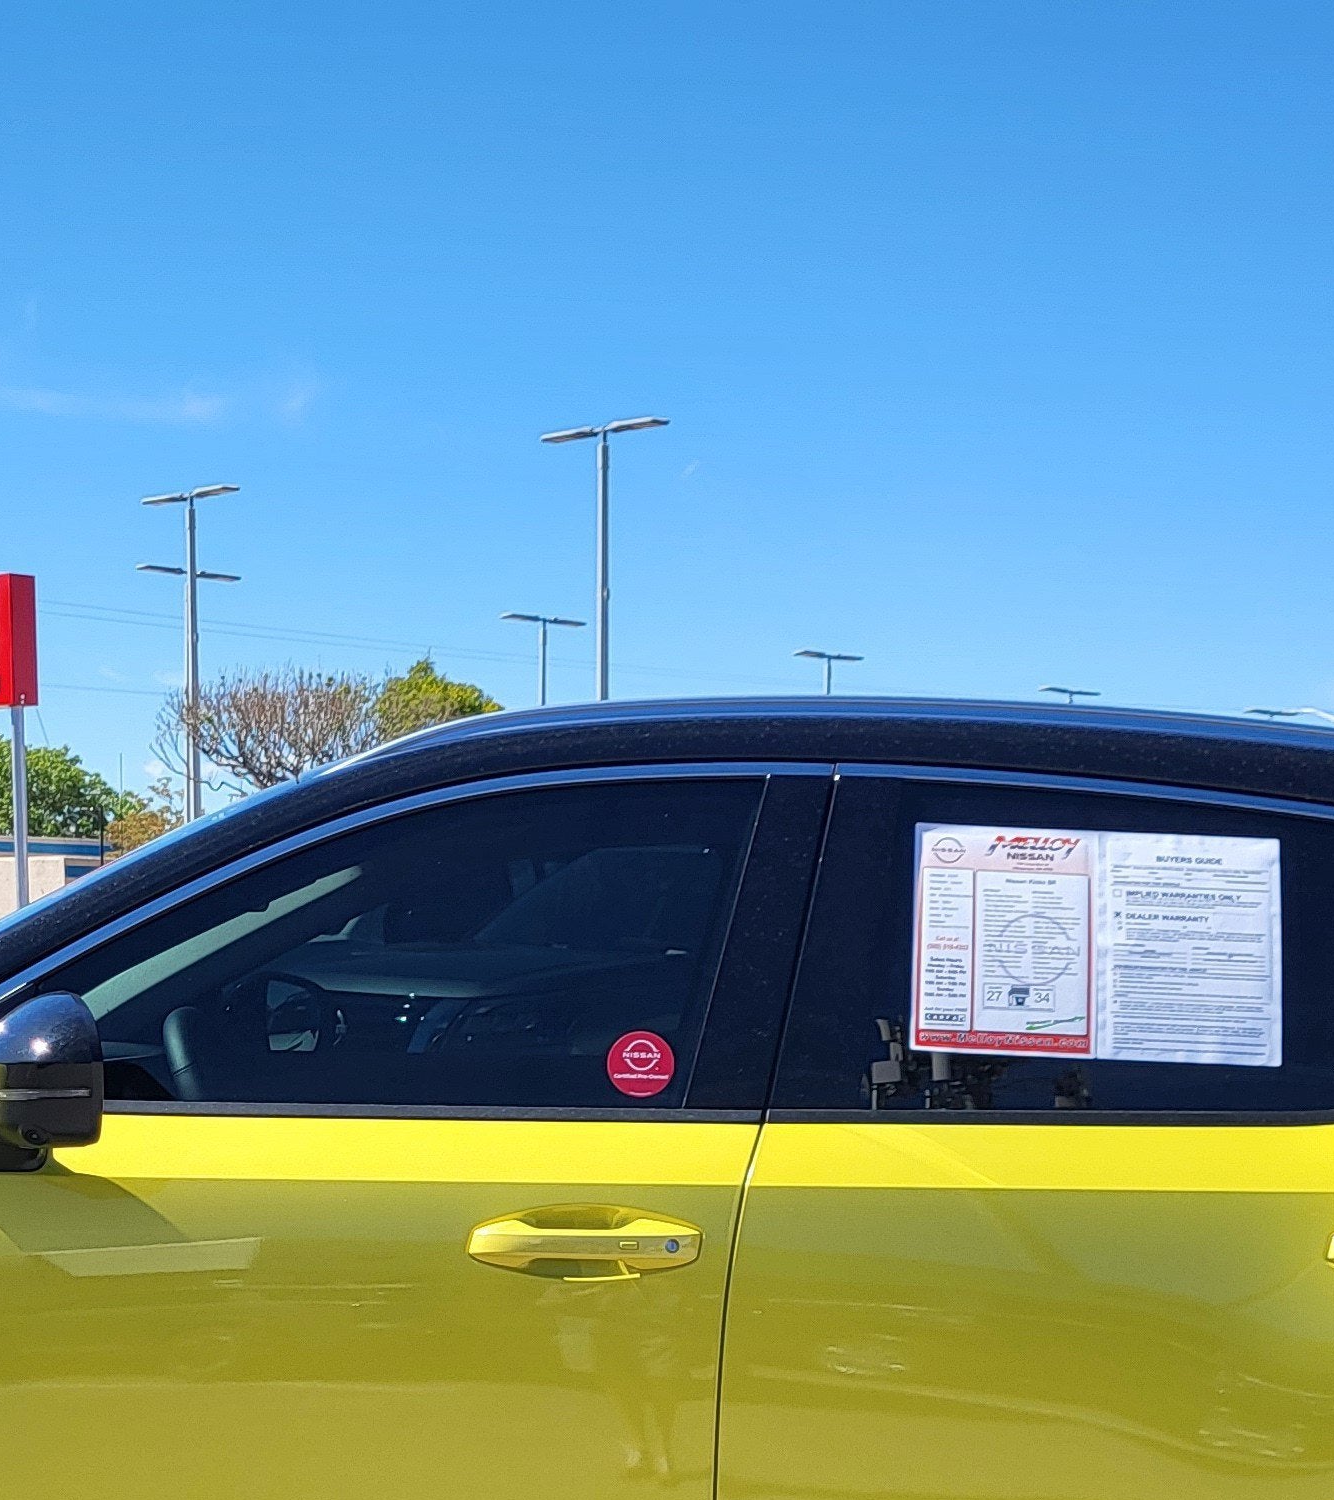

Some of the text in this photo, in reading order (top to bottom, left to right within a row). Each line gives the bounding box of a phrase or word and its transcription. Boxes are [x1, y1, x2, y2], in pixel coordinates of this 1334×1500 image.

[1006, 852, 1055, 862] NISSAN
[986, 990, 1004, 1002] 27
[1034, 992, 1051, 1004] 34
